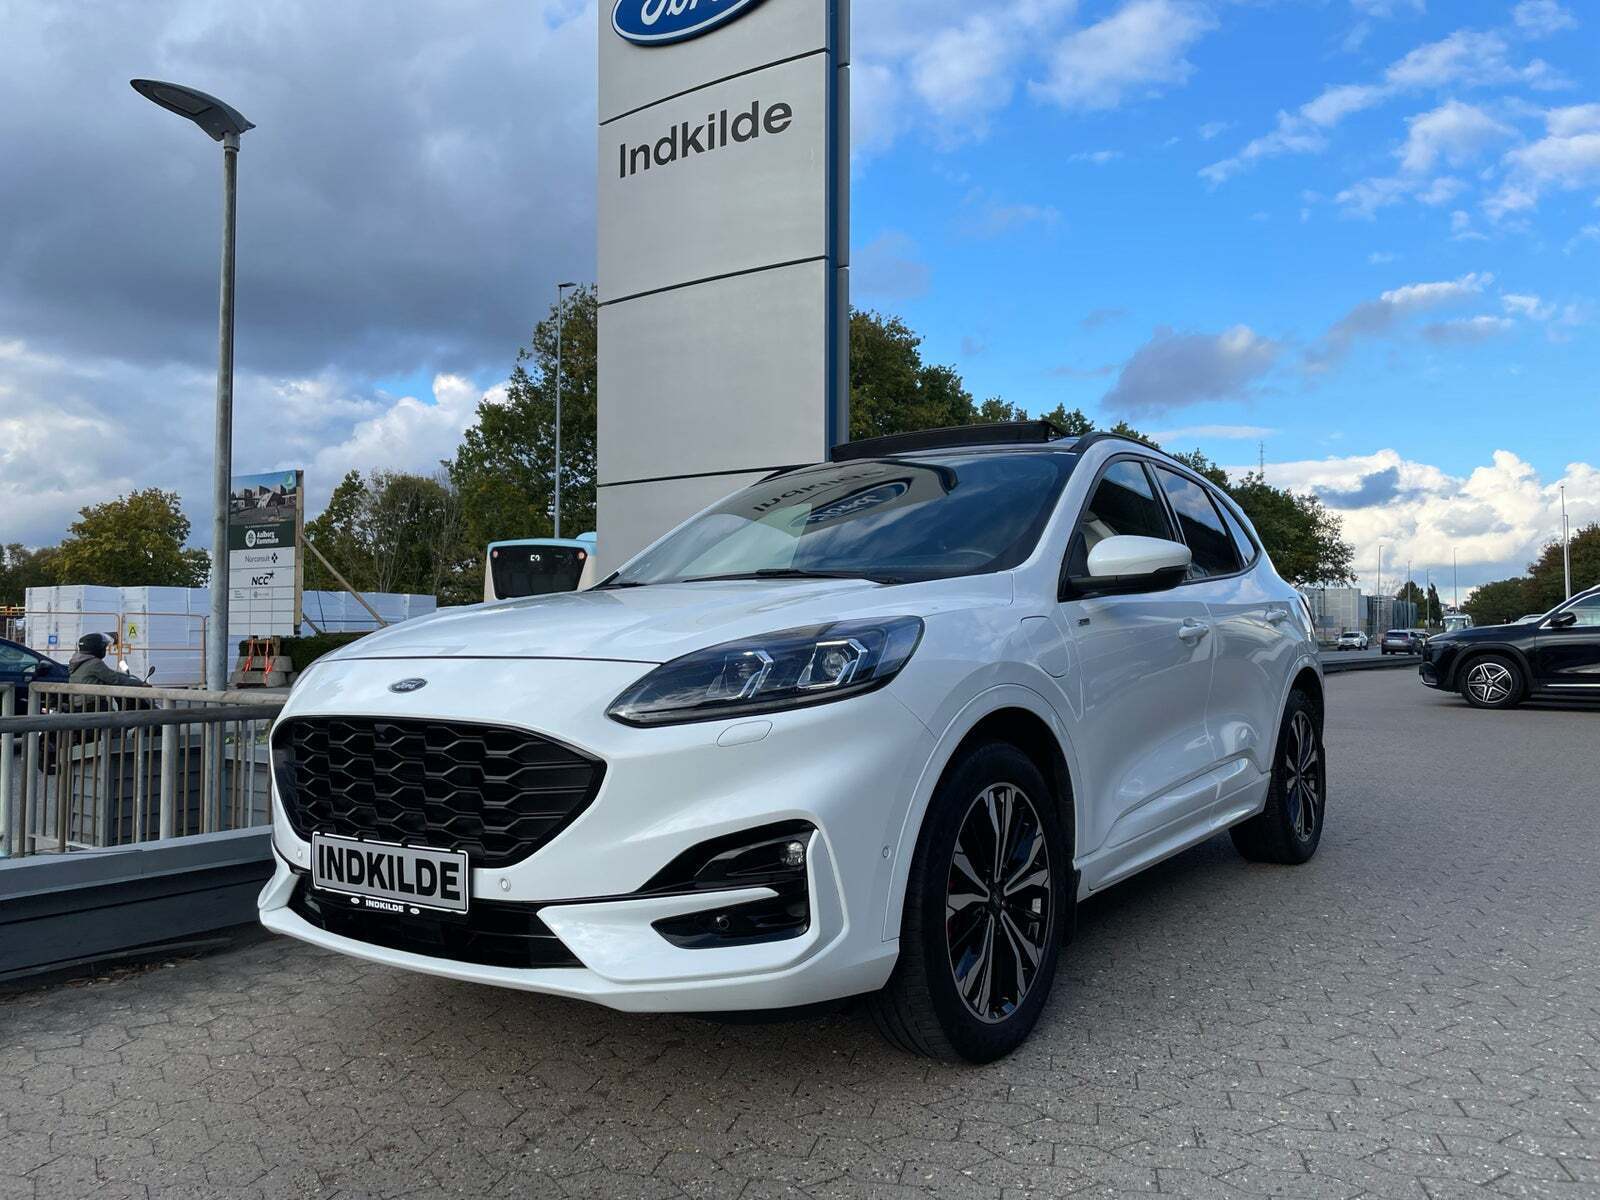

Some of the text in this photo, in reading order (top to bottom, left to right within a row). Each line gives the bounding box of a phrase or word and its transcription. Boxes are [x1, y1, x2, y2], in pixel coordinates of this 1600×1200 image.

[619, 100, 793, 178] Indkilde
[251, 576, 269, 586] NCC
[128, 626, 137, 637] A
[318, 844, 461, 901] INDKILDE
[365, 899, 404, 913] INDKILDE
